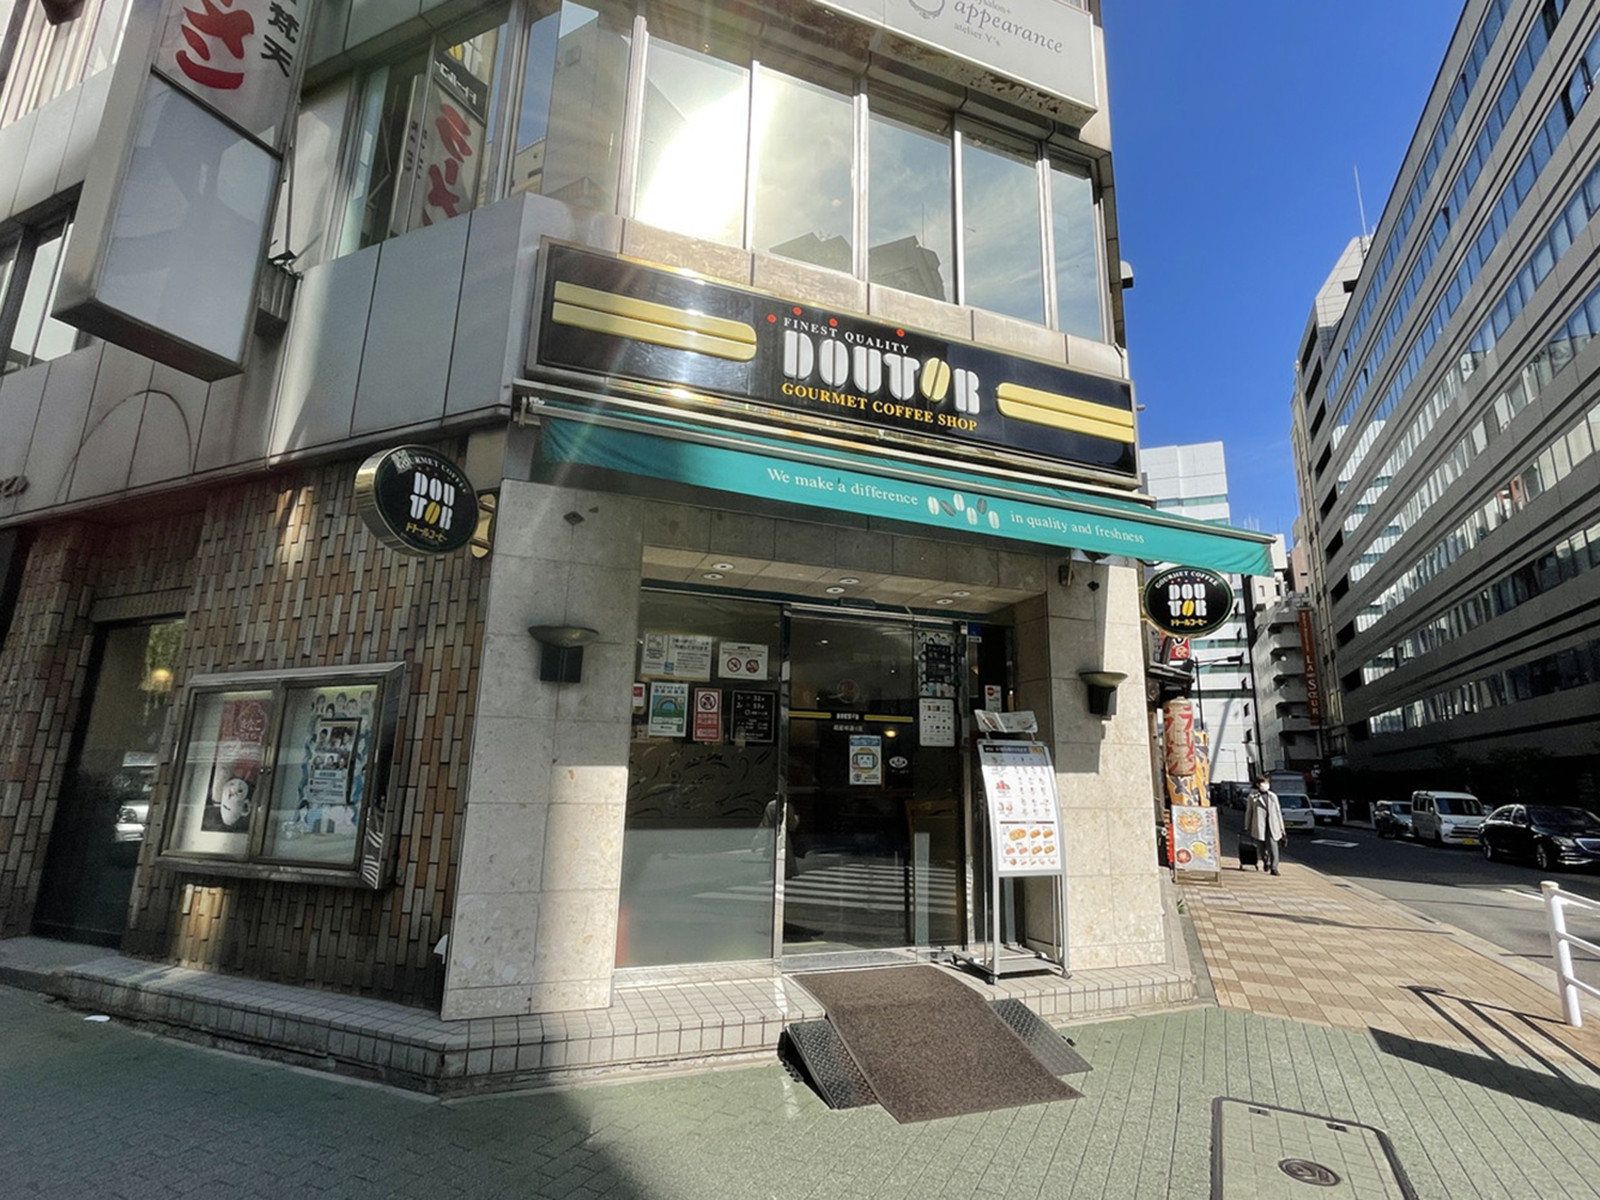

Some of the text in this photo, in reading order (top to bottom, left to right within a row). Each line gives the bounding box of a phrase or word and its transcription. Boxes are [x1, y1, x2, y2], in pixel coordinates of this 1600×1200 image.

[954, 0, 1063, 54] appearance
[954, 23, 983, 40] atelier
[784, 317, 909, 354] FINEST QUALITY
[783, 330, 981, 415] DOUTOR
[781, 382, 978, 431] GOURMET COFFEE SHOP
[413, 471, 455, 507] DOU
[767, 467, 1145, 544] We make a difference in quality and freshness
[409, 494, 454, 531] TOR
[1155, 570, 1220, 589] GOURMET COFFEE
[1168, 583, 1206, 600] DOU
[1167, 600, 1207, 617] TOR
